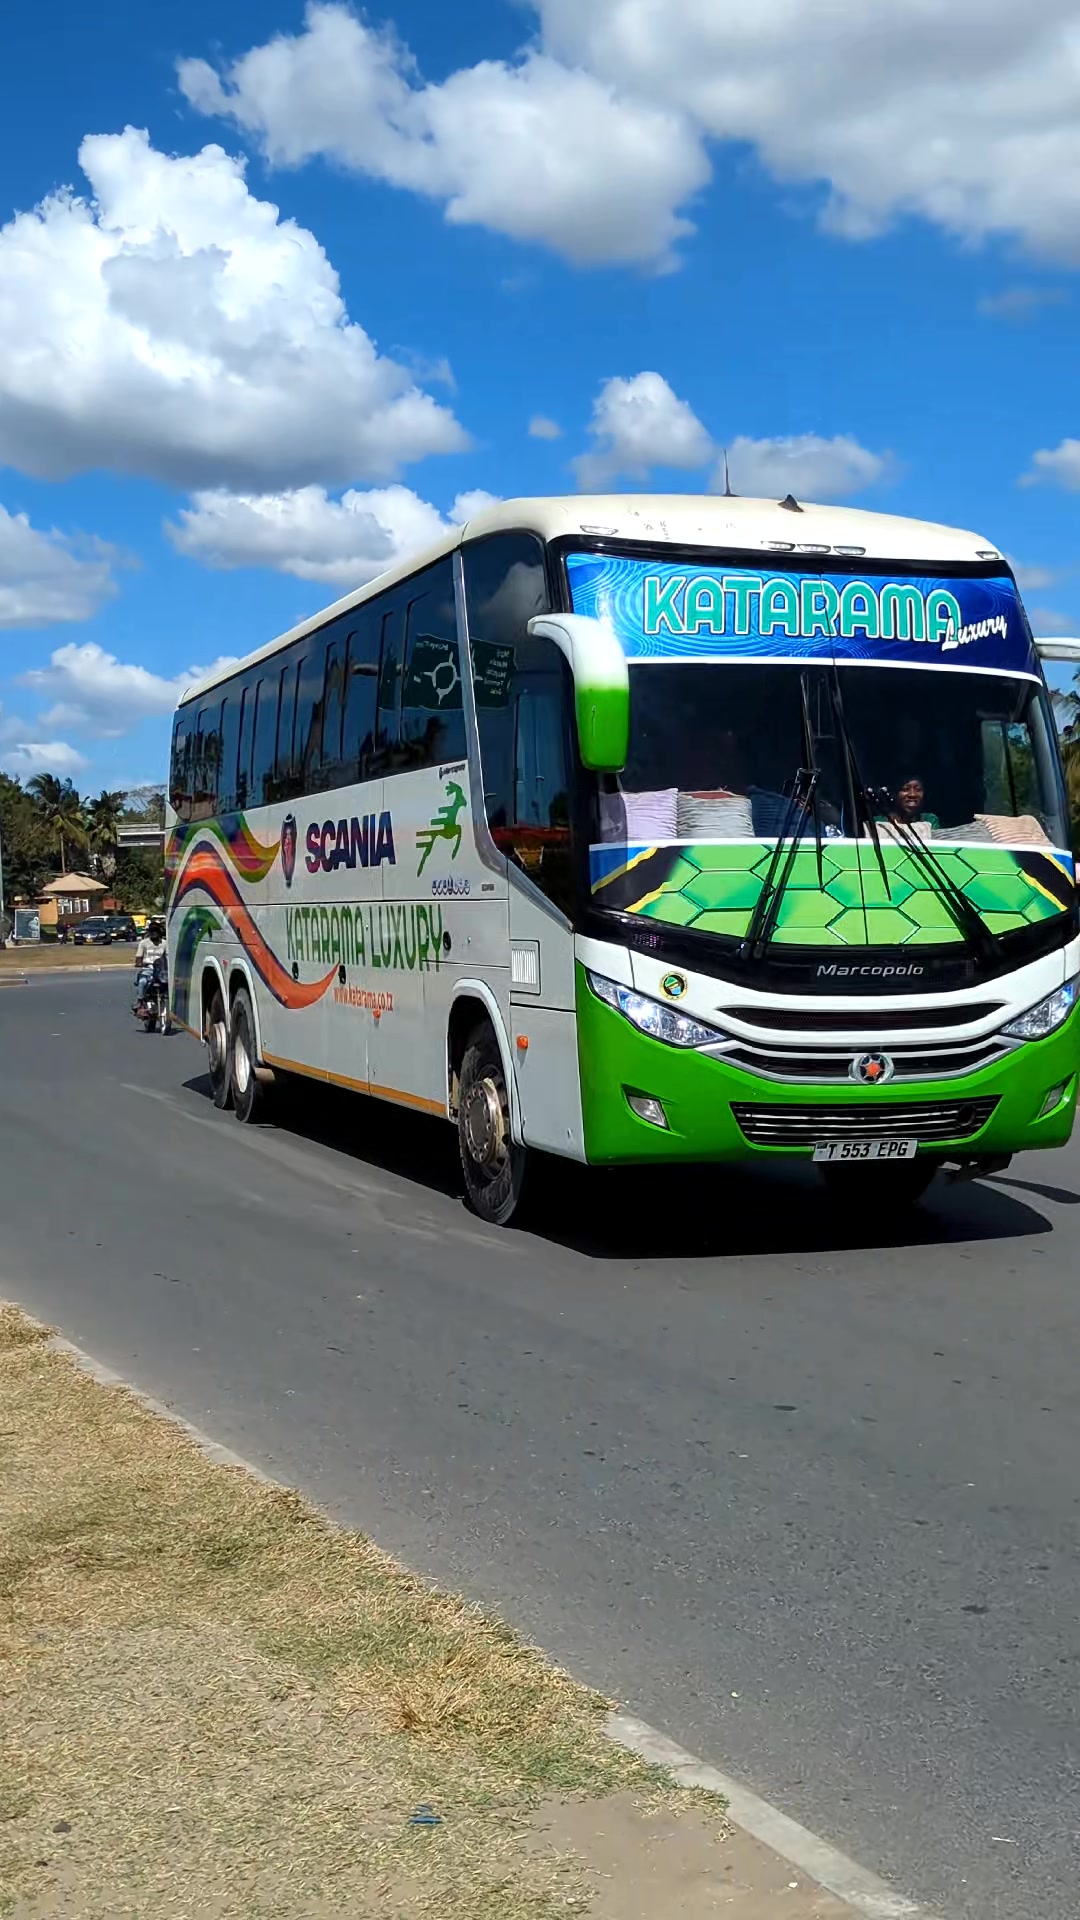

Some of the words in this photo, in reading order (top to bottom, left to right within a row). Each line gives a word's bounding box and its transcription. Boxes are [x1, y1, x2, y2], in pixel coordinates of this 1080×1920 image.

[643, 576, 962, 643] KATARAMA
[941, 615, 1008, 652] Luxury
[304, 811, 397, 874] SCANIA
[285, 905, 366, 967] KATARAMA
[369, 903, 443, 973] LUXURY
[816, 963, 924, 978] Marcopolo
[828, 1143, 838, 1159] T
[840, 1142, 873, 1159] 553
[877, 1141, 909, 1157] EPG
